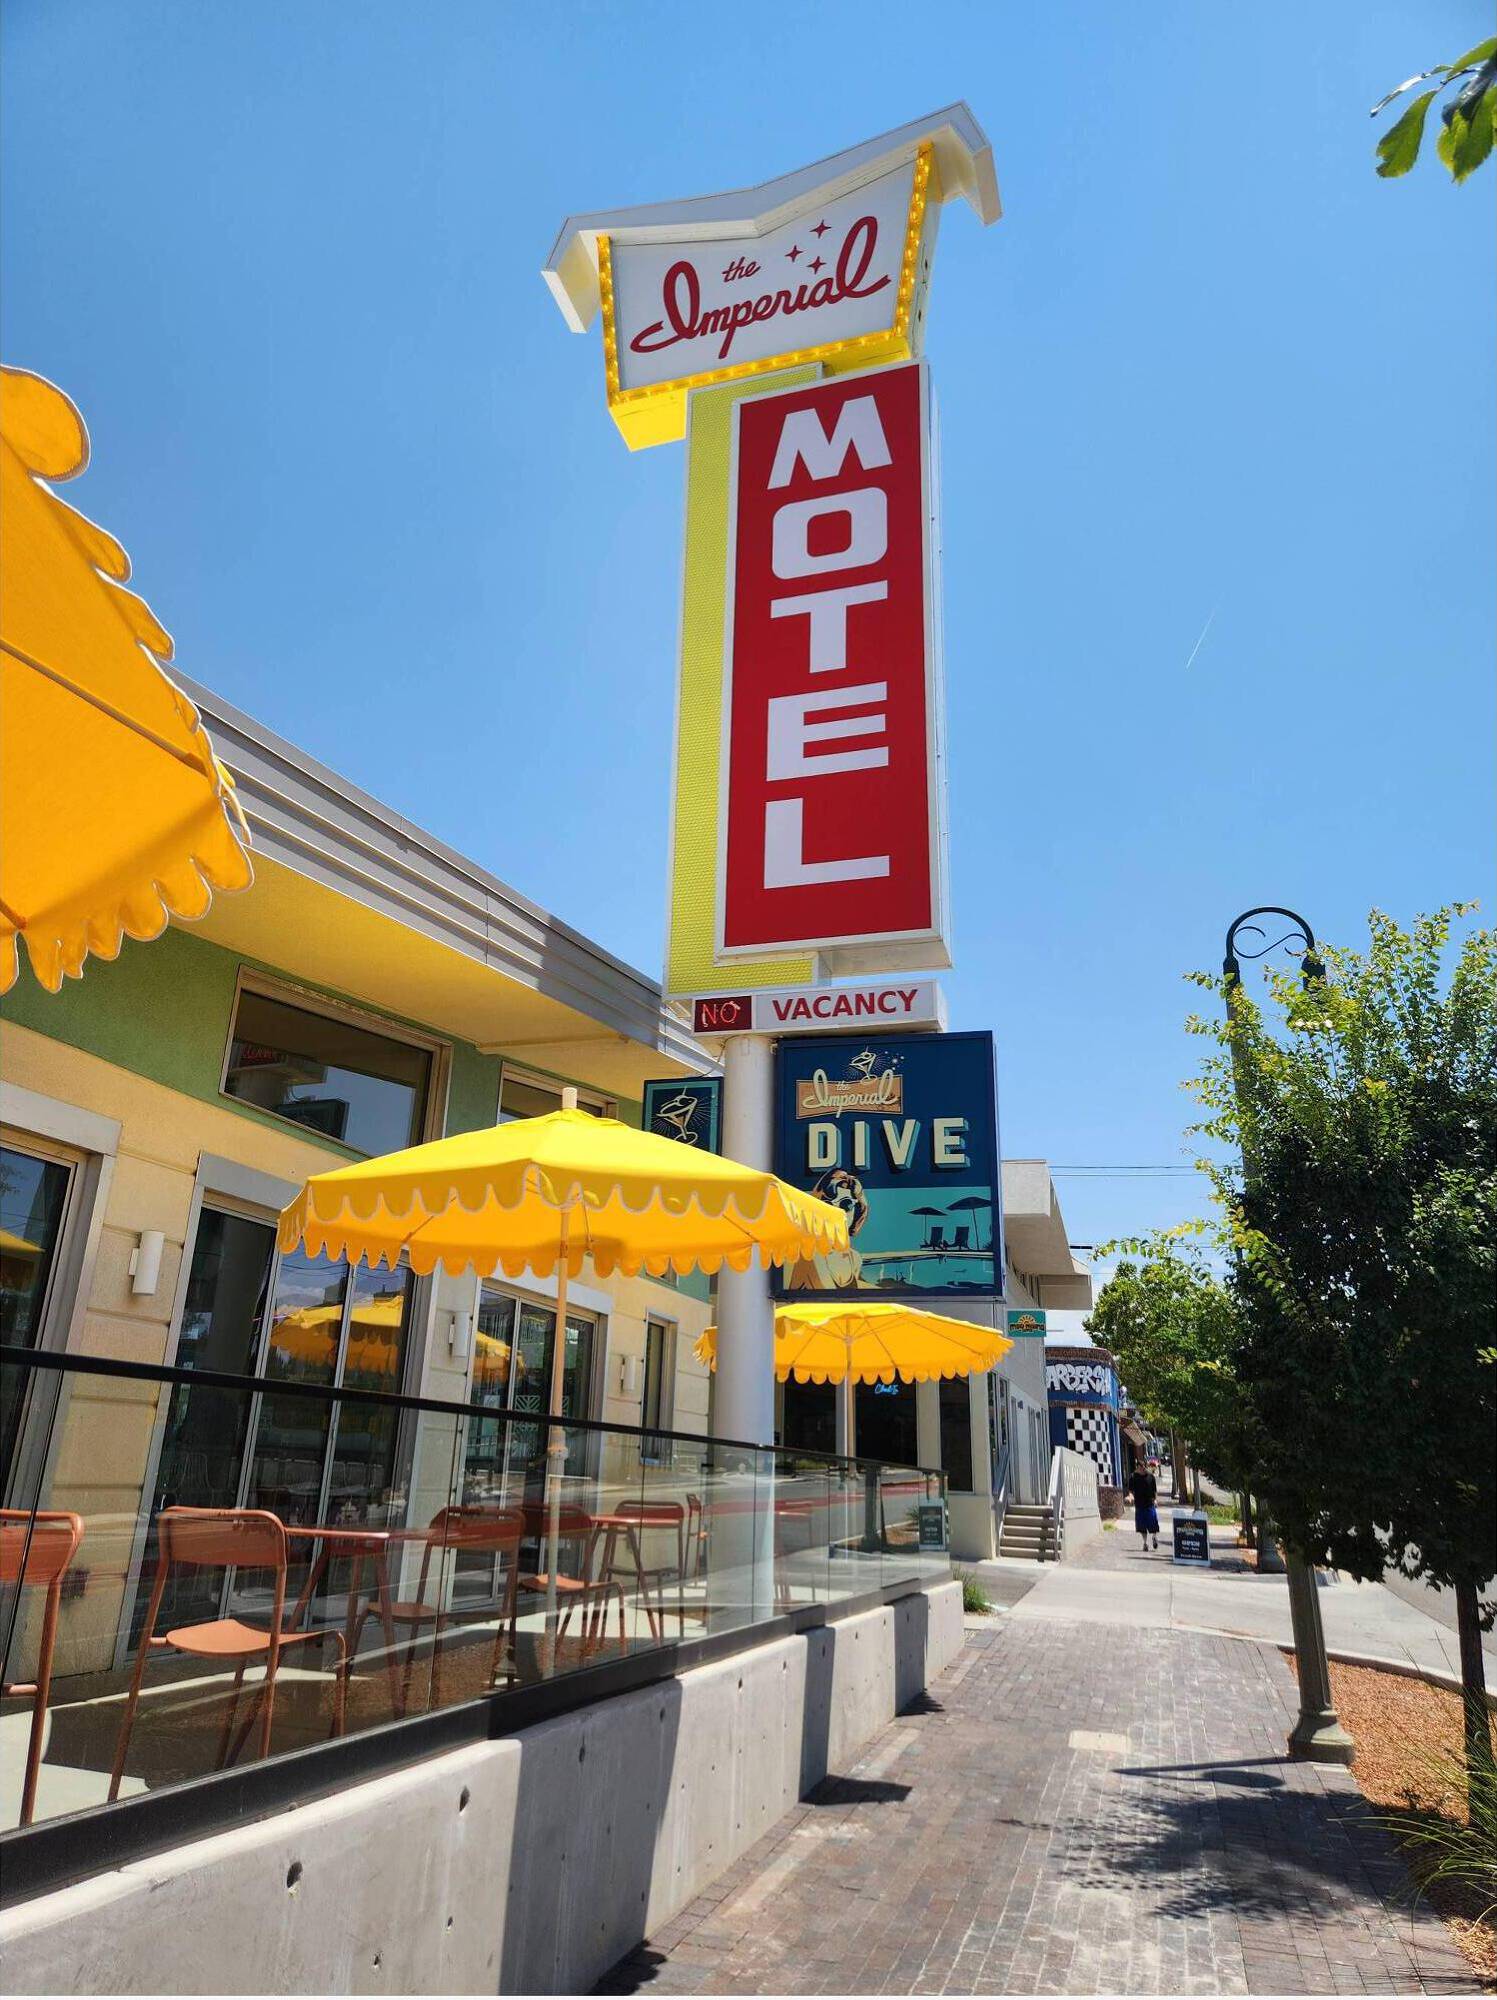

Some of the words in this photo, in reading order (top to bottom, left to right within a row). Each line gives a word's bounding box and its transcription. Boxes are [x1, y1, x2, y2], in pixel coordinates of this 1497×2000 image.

[630, 215, 892, 359] Imperial
[722, 256, 761, 283] the
[764, 394, 893, 889] MOTEL
[702, 1000, 742, 1028] NO
[771, 989, 918, 1021] VACANCY
[802, 1068, 901, 1118] Imperial
[808, 1117, 970, 1171] DIVE
